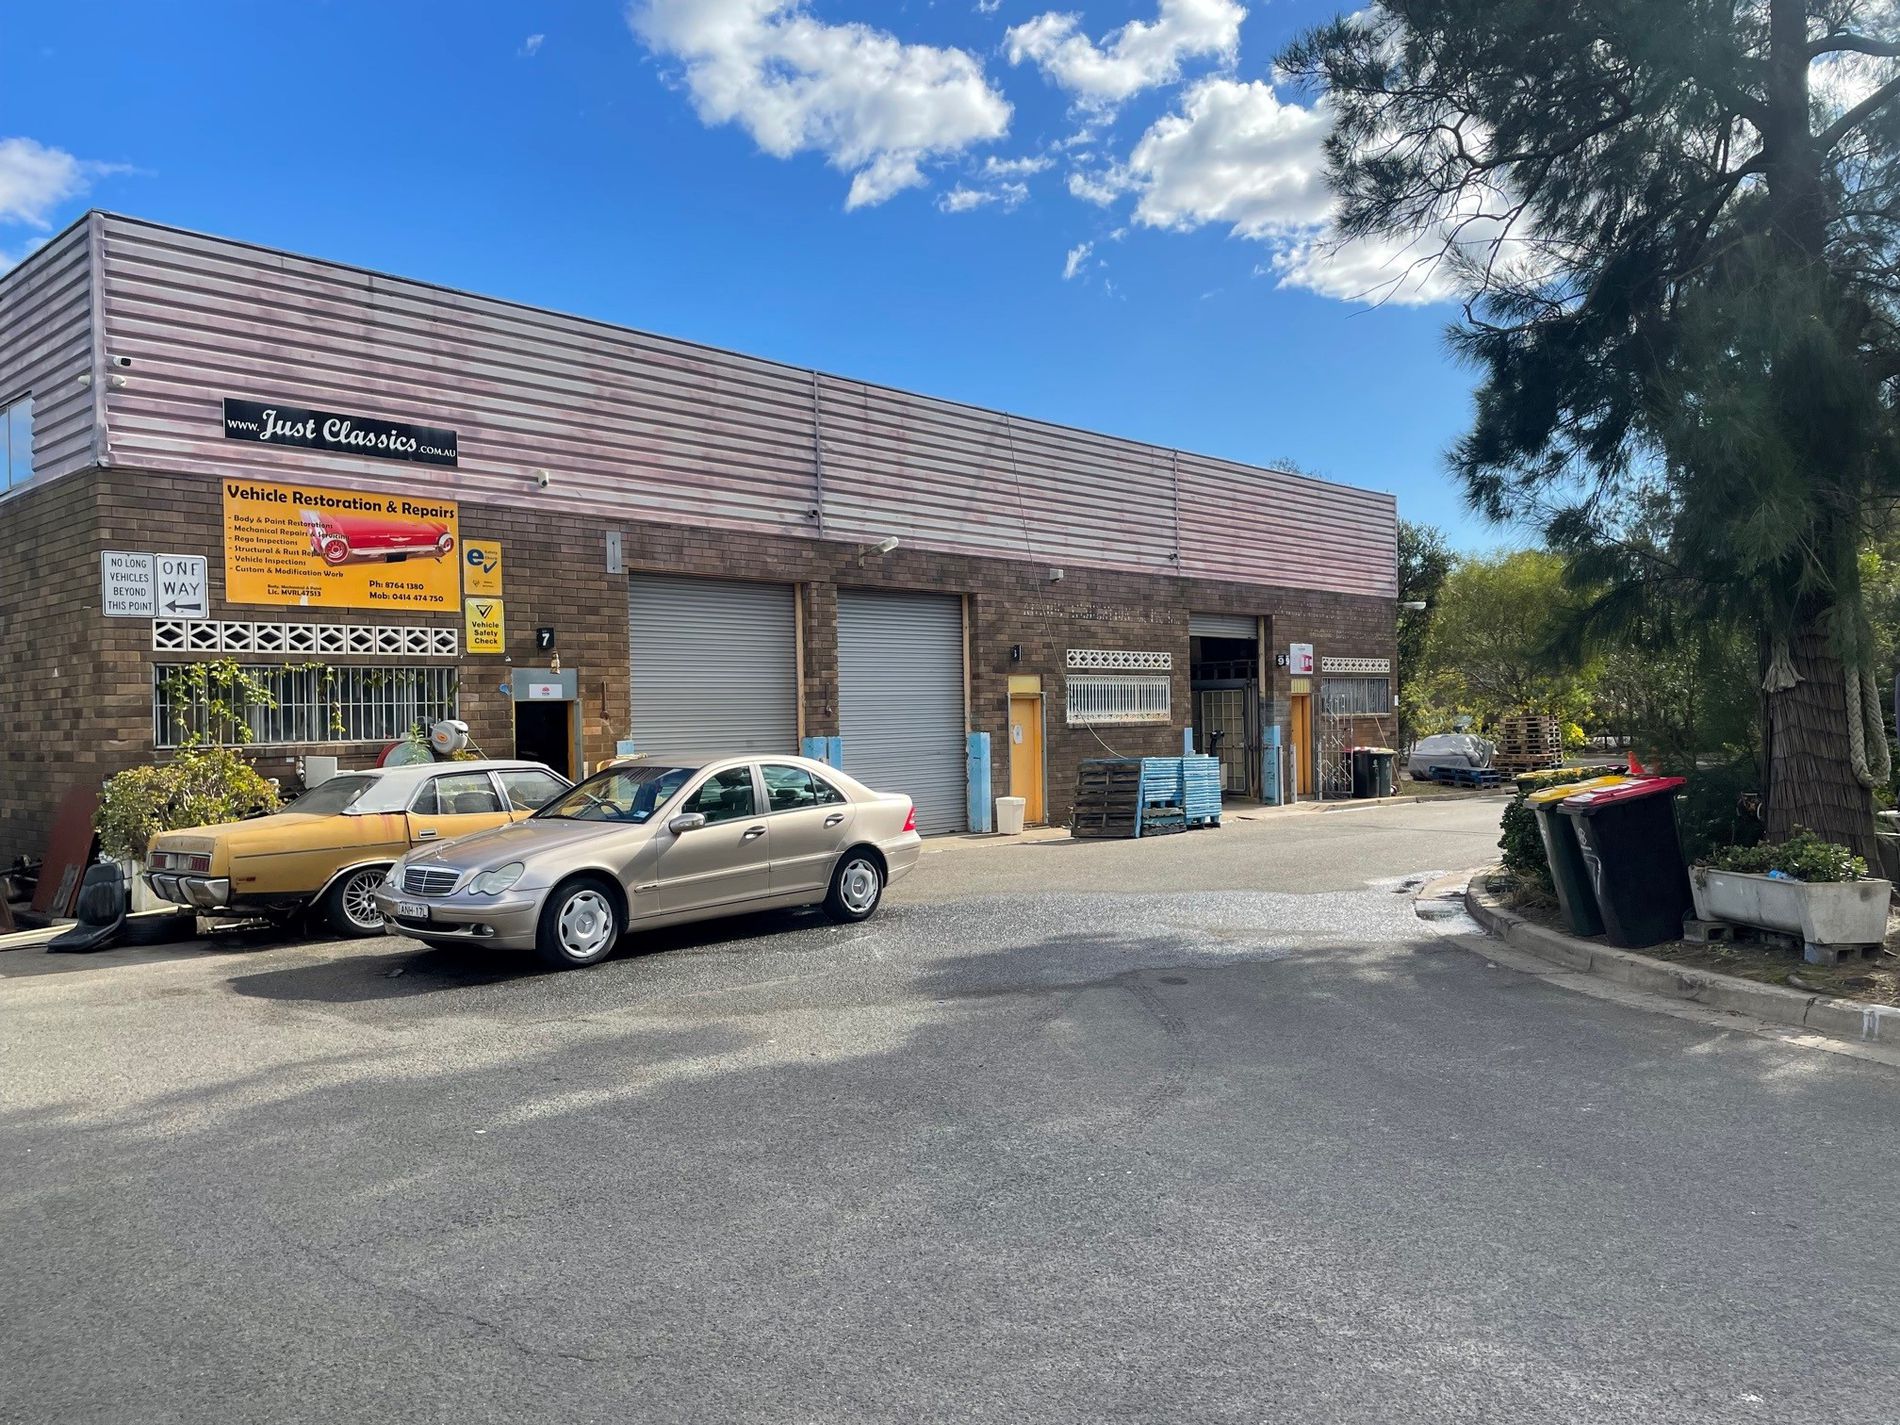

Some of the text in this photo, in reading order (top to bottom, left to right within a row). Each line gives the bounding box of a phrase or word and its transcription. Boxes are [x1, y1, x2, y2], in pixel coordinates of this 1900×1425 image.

[260, 409, 316, 440] Just
[322, 418, 417, 452] Classics
[227, 484, 454, 518] Vehicle Restoration & Repairs
[234, 515, 254, 524] Body
[265, 517, 285, 525] Paint
[288, 520, 333, 529] Restorations
[234, 526, 278, 534] Mechanical
[280, 529, 308, 537] Repairs
[256, 536, 298, 545] Inspections
[234, 546, 273, 554] Structural
[111, 558, 147, 568] NO LONG
[265, 556, 306, 566] Inspections
[275, 568, 321, 576] Modification
[110, 573, 149, 582] VEHICLES
[164, 582, 200, 596] WAY
[369, 580, 384, 588] Ph:
[114, 587, 146, 596] BEYOND
[369, 592, 390, 600] Mob:
[108, 601, 153, 611] THIS POINT
[542, 633, 550, 646] 7
